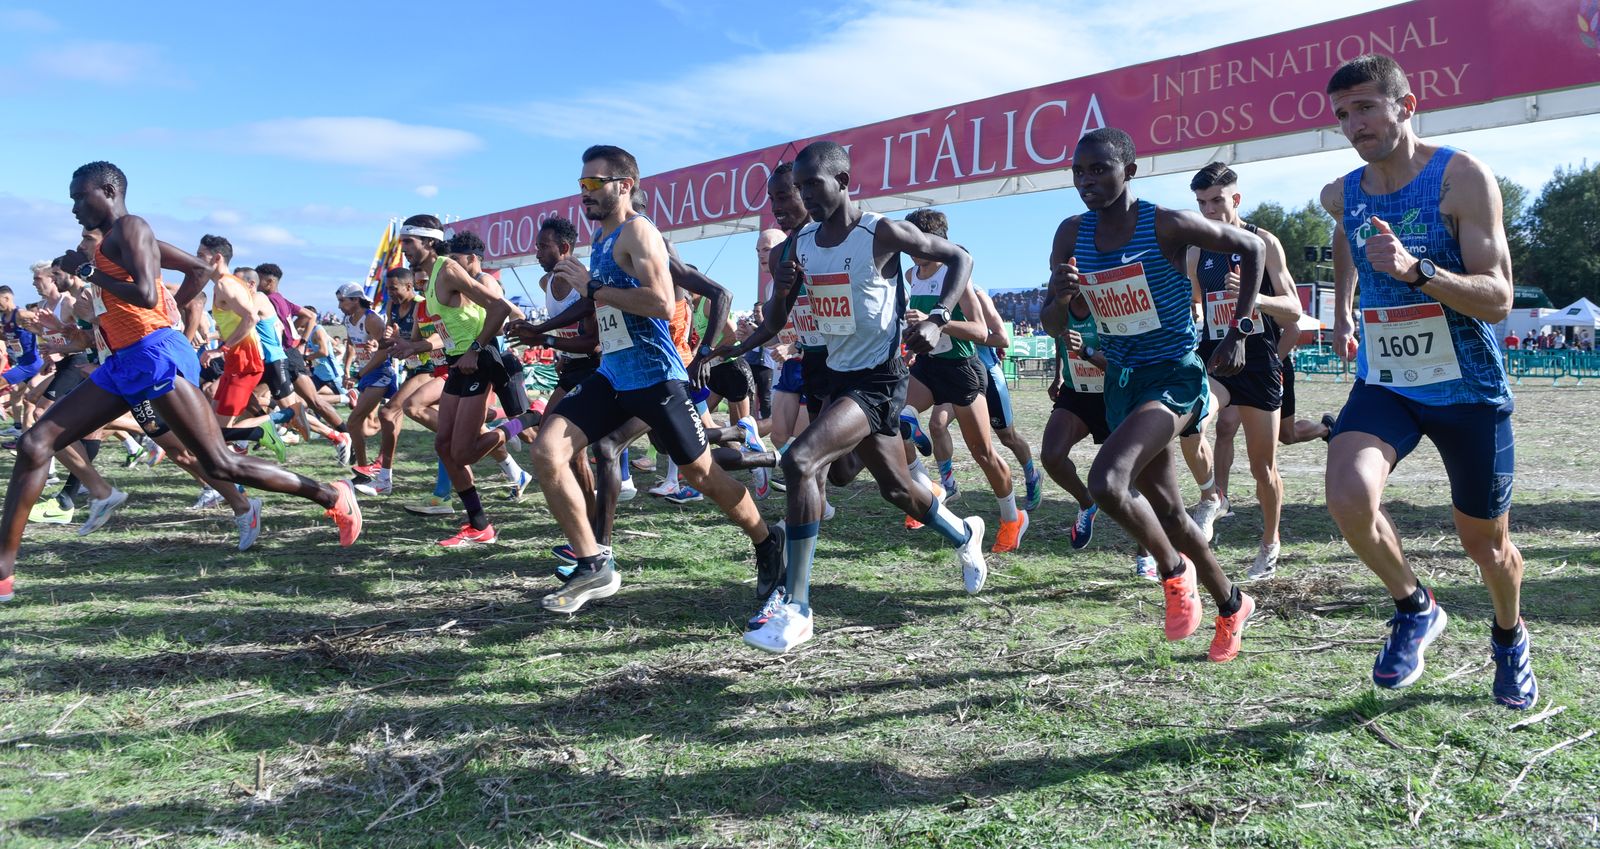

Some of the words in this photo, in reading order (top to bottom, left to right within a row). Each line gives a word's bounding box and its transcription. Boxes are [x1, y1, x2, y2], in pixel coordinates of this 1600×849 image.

[1152, 16, 1449, 103] INTERNATIONAL
[1149, 102, 1254, 146] CROSS
[1269, 63, 1471, 125] CORY
[487, 209, 558, 257] CROS
[880, 92, 1108, 191] ITÁLICA
[1086, 284, 1152, 318] Waithaka
[1378, 331, 1434, 358] 1607
